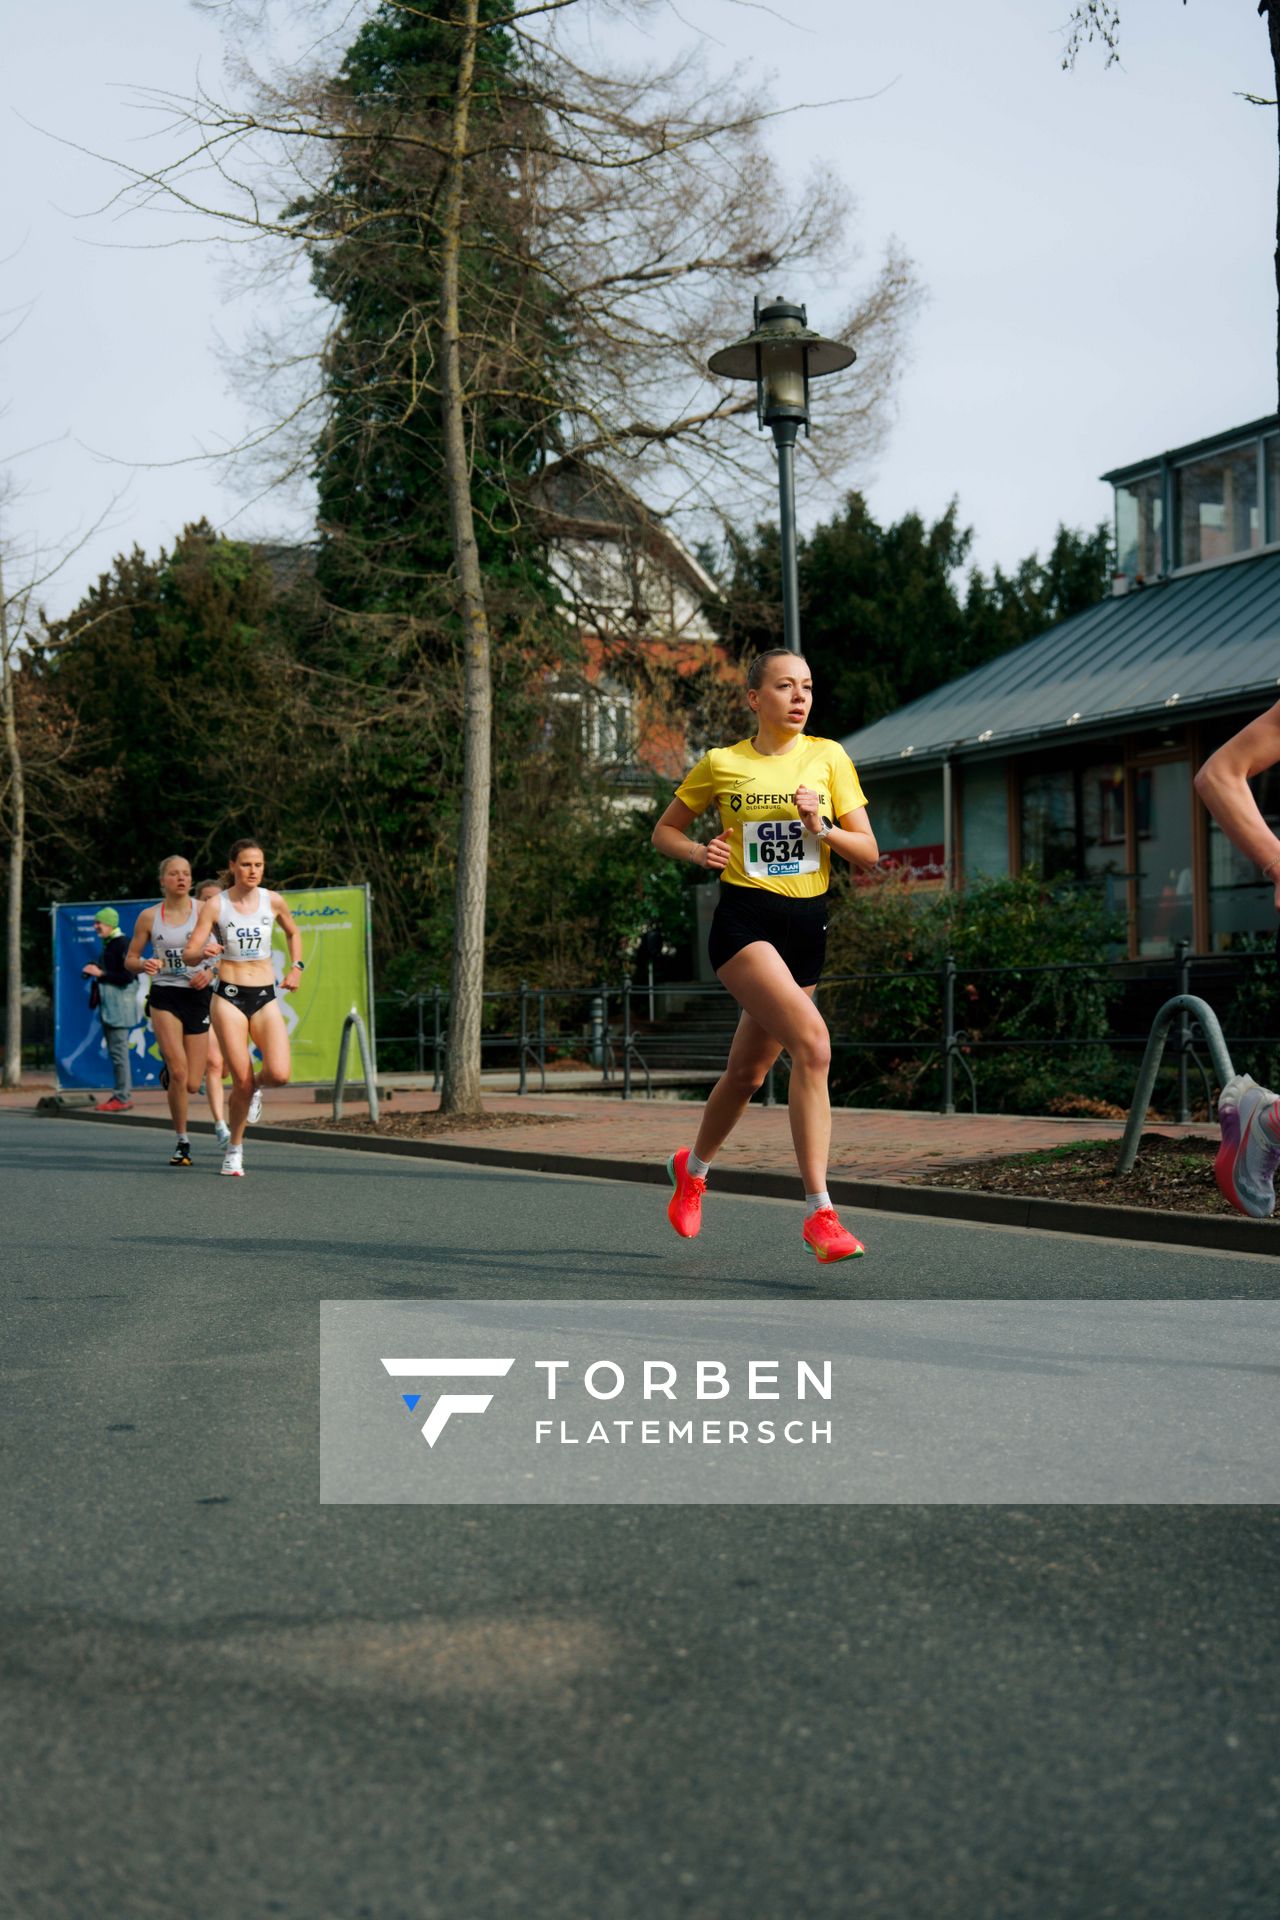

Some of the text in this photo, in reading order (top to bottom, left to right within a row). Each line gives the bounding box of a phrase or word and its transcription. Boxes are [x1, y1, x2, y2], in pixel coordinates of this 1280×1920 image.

[757, 821, 802, 841] GLS
[760, 840, 805, 863] 634
[235, 927, 261, 938] GLS
[237, 937, 262, 950] 177
[164, 949, 184, 959] GL
